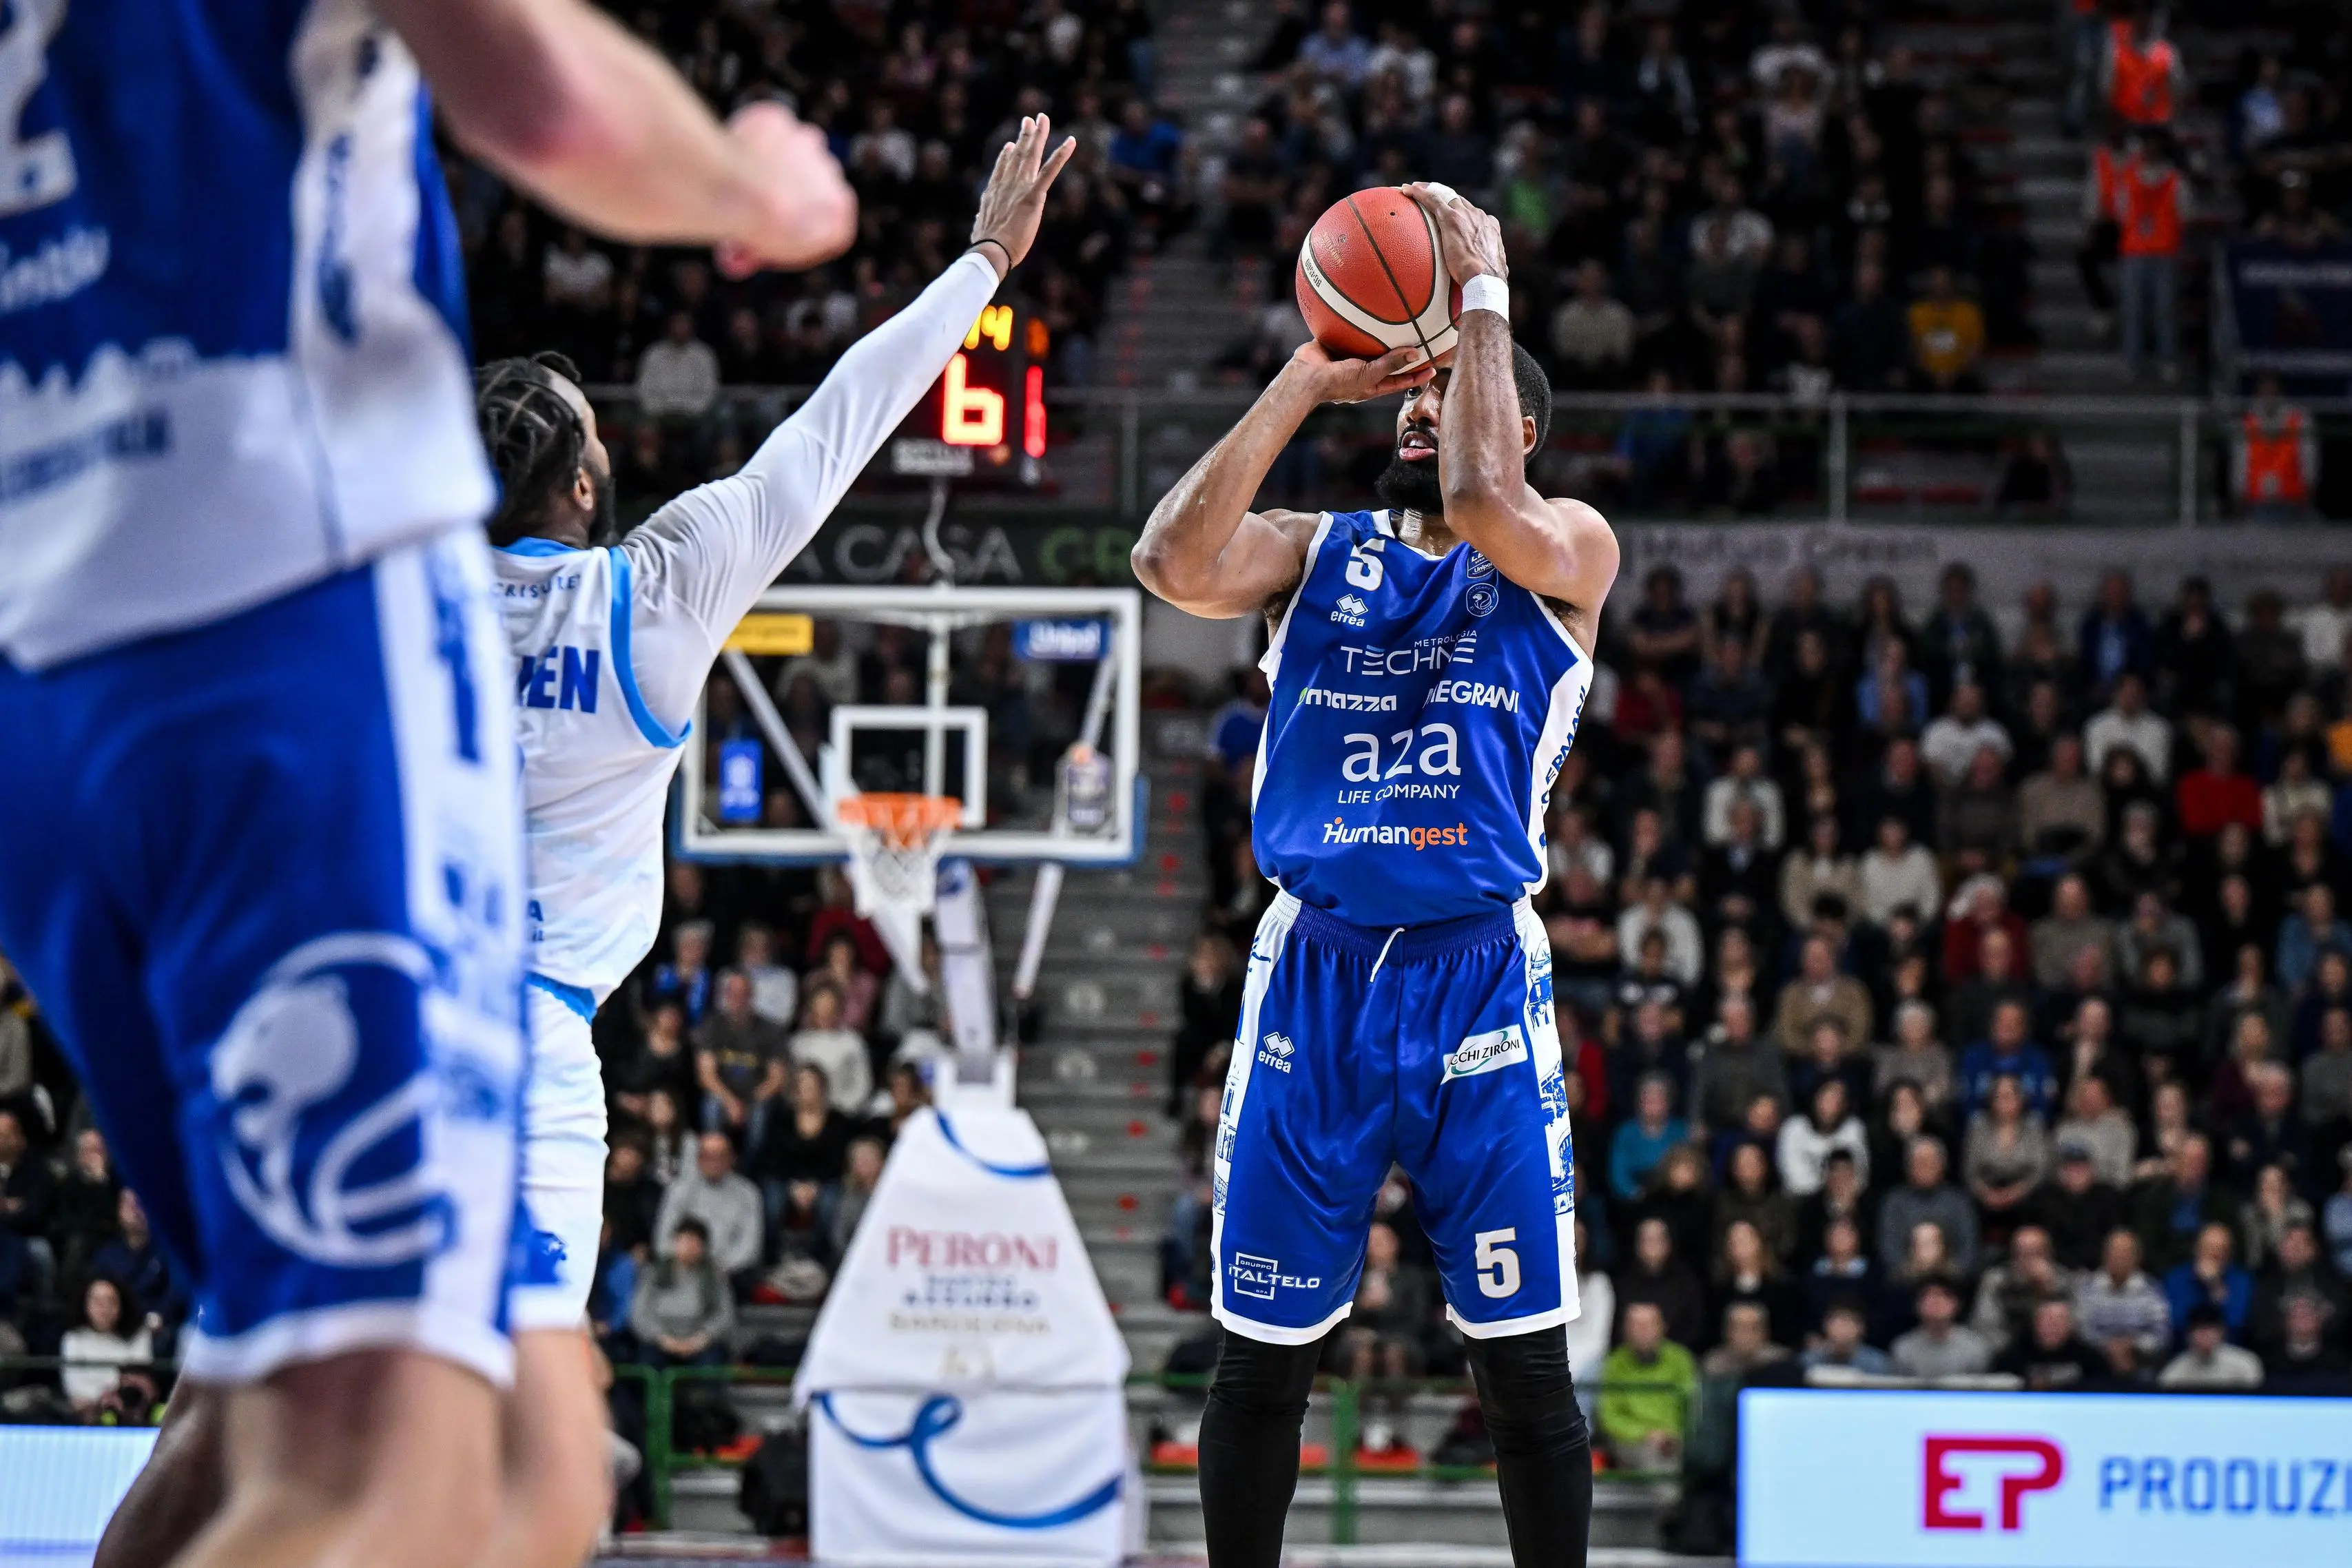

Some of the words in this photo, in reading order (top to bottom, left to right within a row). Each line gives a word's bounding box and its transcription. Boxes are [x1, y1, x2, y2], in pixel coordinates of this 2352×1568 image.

[1345, 537, 1386, 592] 5
[1338, 790, 1371, 804] LIFE
[1375, 784, 1461, 802] COMPANY
[1323, 816, 1469, 851] Humangest
[1481, 1039, 1520, 1059] ZIRONI
[887, 1226, 1059, 1270] PERONI
[1240, 1259, 1272, 1270] GRUPPO
[1475, 1227, 1521, 1299] 5
[1228, 1263, 1321, 1288] ITALTELO
[1924, 1437, 2061, 1531] EP
